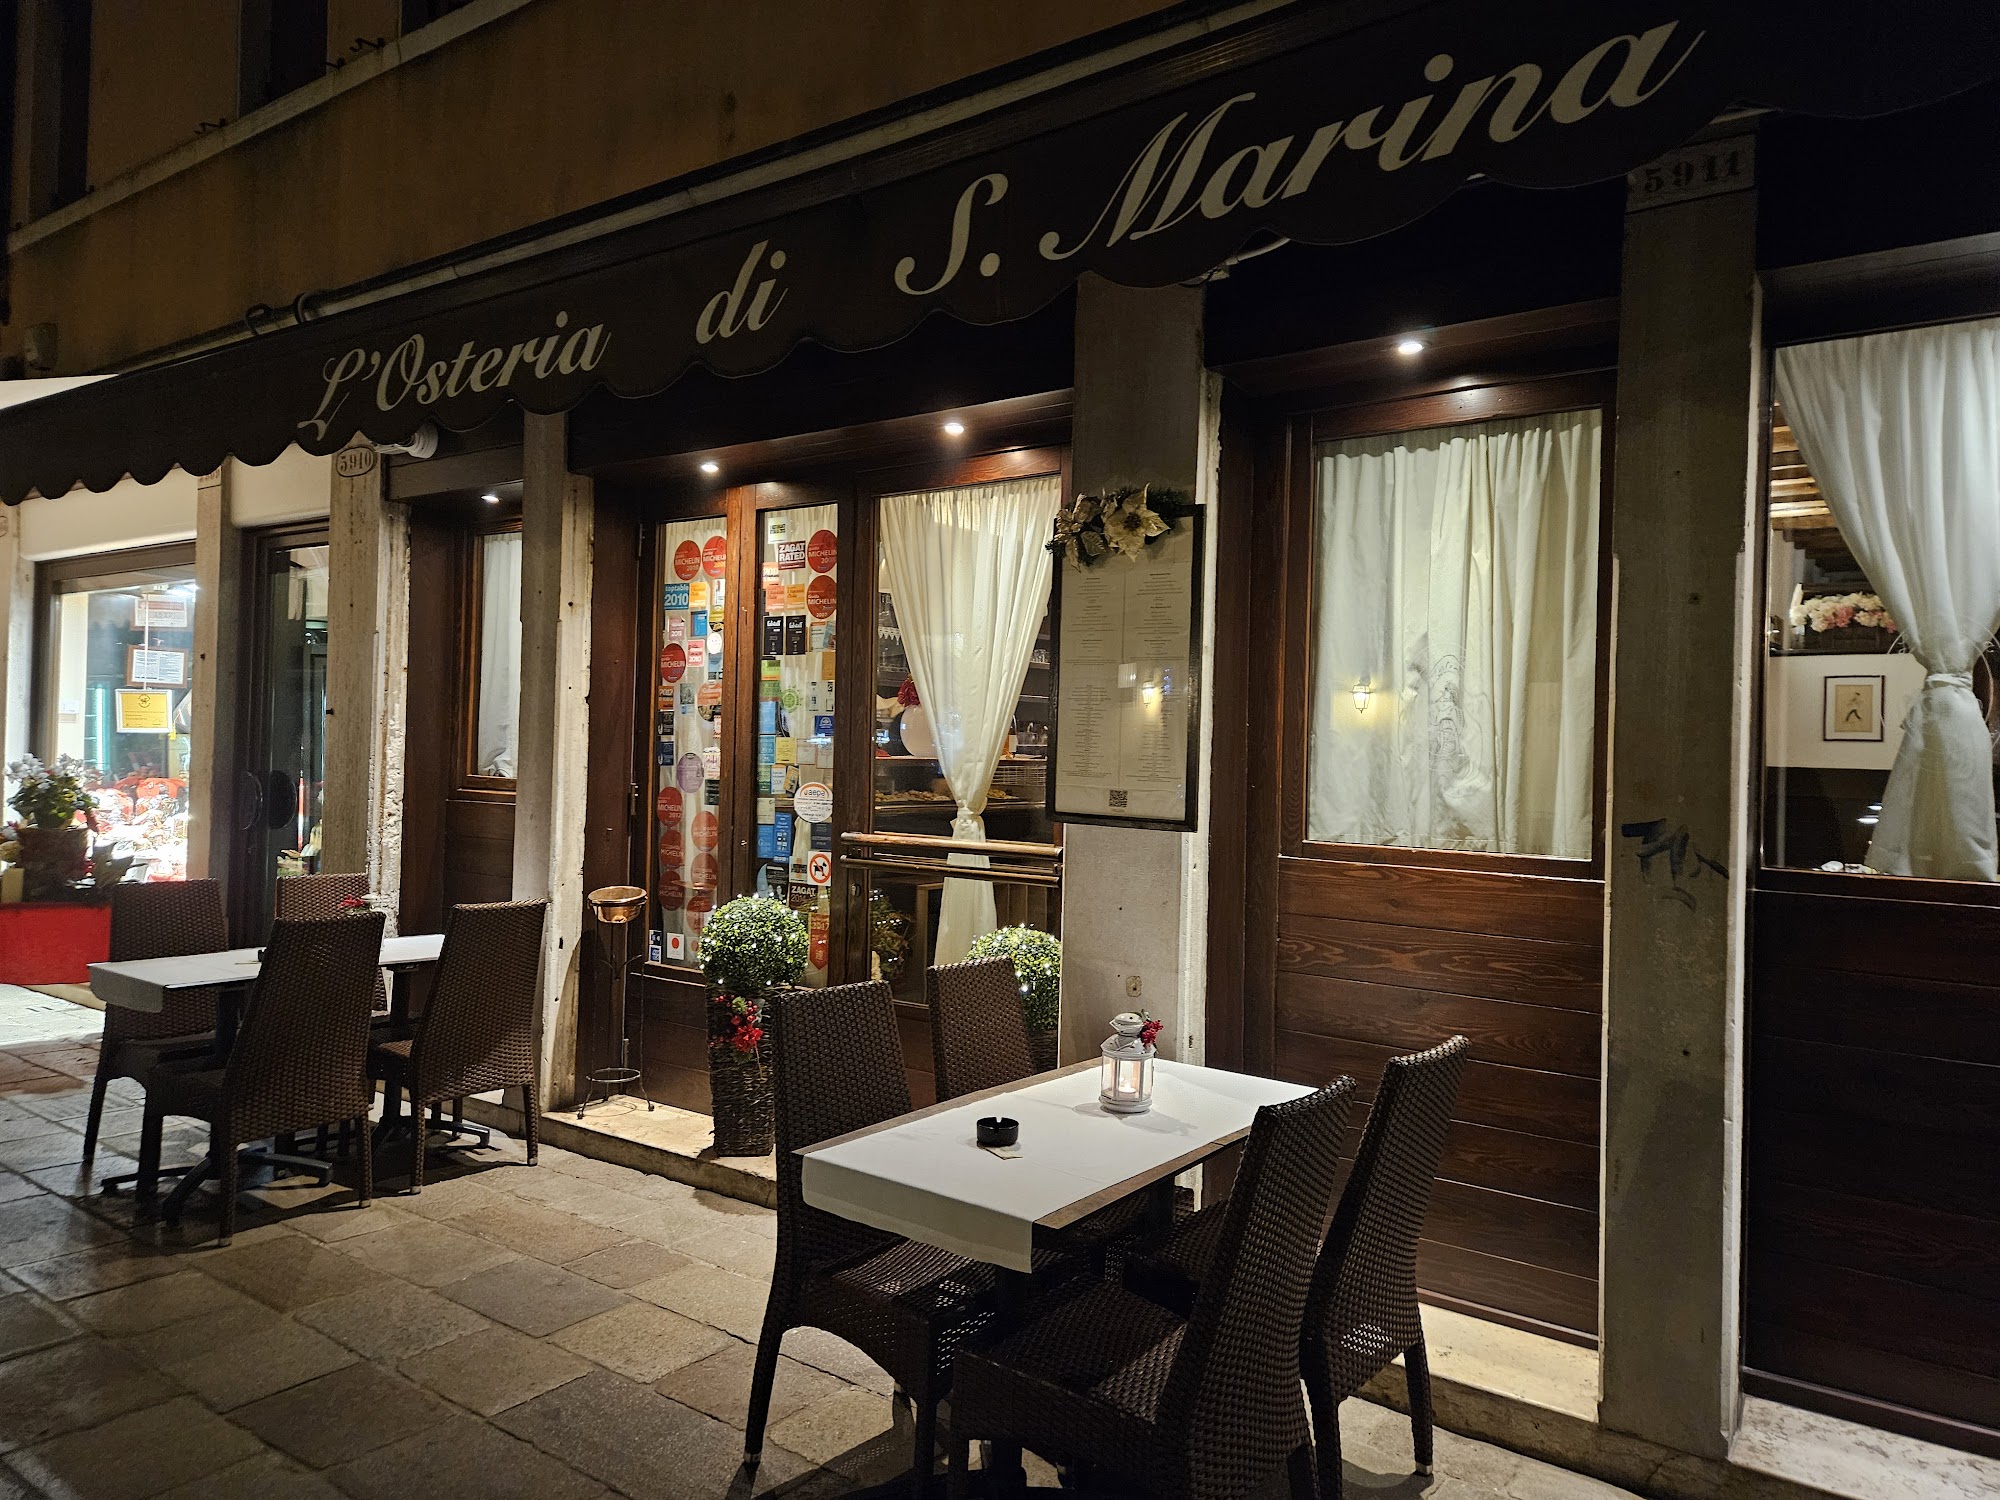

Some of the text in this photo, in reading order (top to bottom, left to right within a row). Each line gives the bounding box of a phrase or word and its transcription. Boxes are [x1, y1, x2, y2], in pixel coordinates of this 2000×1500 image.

[1644, 150, 1741, 193] 5911
[298, 20, 1705, 441] L'Osteria di S. Marina
[339, 451, 373, 472] 5910
[779, 543, 805, 553] ZAGAT
[779, 552, 805, 562] RATED
[808, 549, 837, 558] MICHELIN
[675, 557, 700, 566] MICHELIN
[664, 593, 689, 606] 2010
[661, 660, 686, 668] MICHELIN
[658, 804, 682, 812] MICHELIN
[791, 885, 816, 896] ZAGAT
